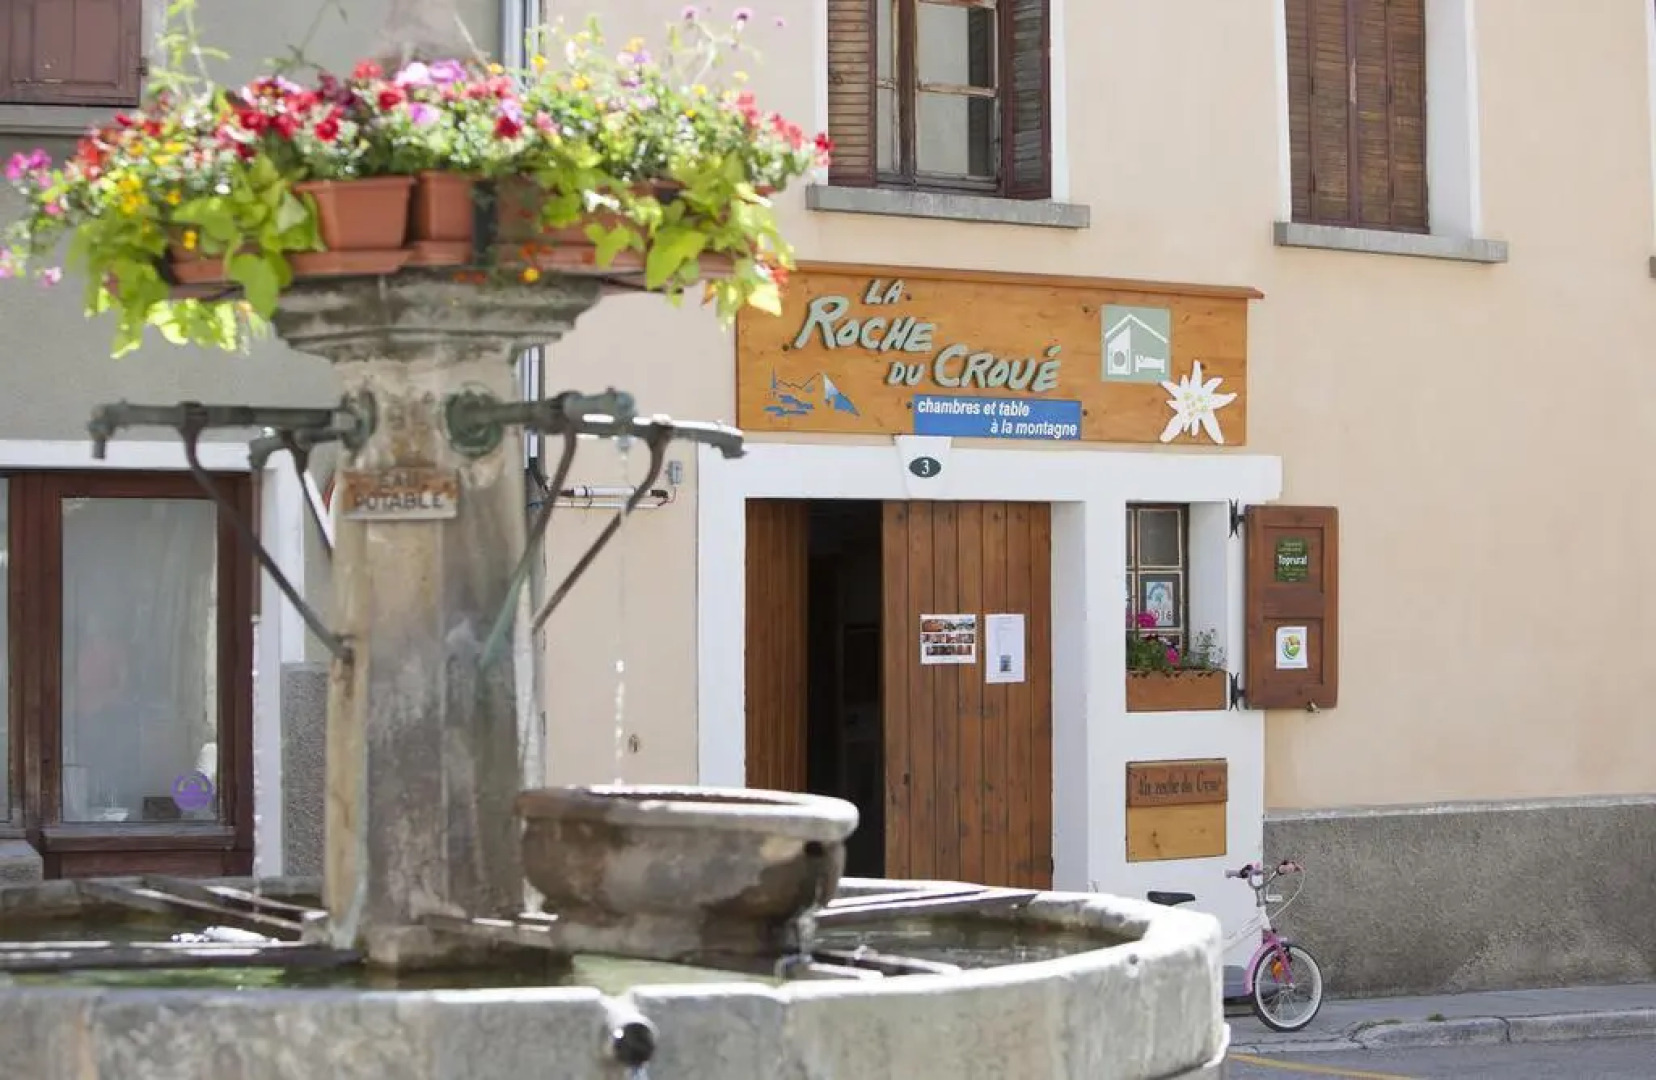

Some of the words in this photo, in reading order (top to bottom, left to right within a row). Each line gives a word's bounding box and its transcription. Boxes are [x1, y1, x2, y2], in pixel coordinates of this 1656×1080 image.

[863, 278, 905, 305] LA
[794, 295, 936, 352] ROCHE
[886, 360, 925, 387] DU
[933, 343, 1062, 393] CROUÉ
[918, 398, 980, 415] chambres
[983, 401, 996, 416] et
[999, 402, 1030, 417] table
[990, 419, 998, 434] à
[1001, 419, 1013, 434] la
[1015, 421, 1077, 439] montagne
[921, 459, 930, 475] 3
[354, 491, 446, 511] POTABLE
